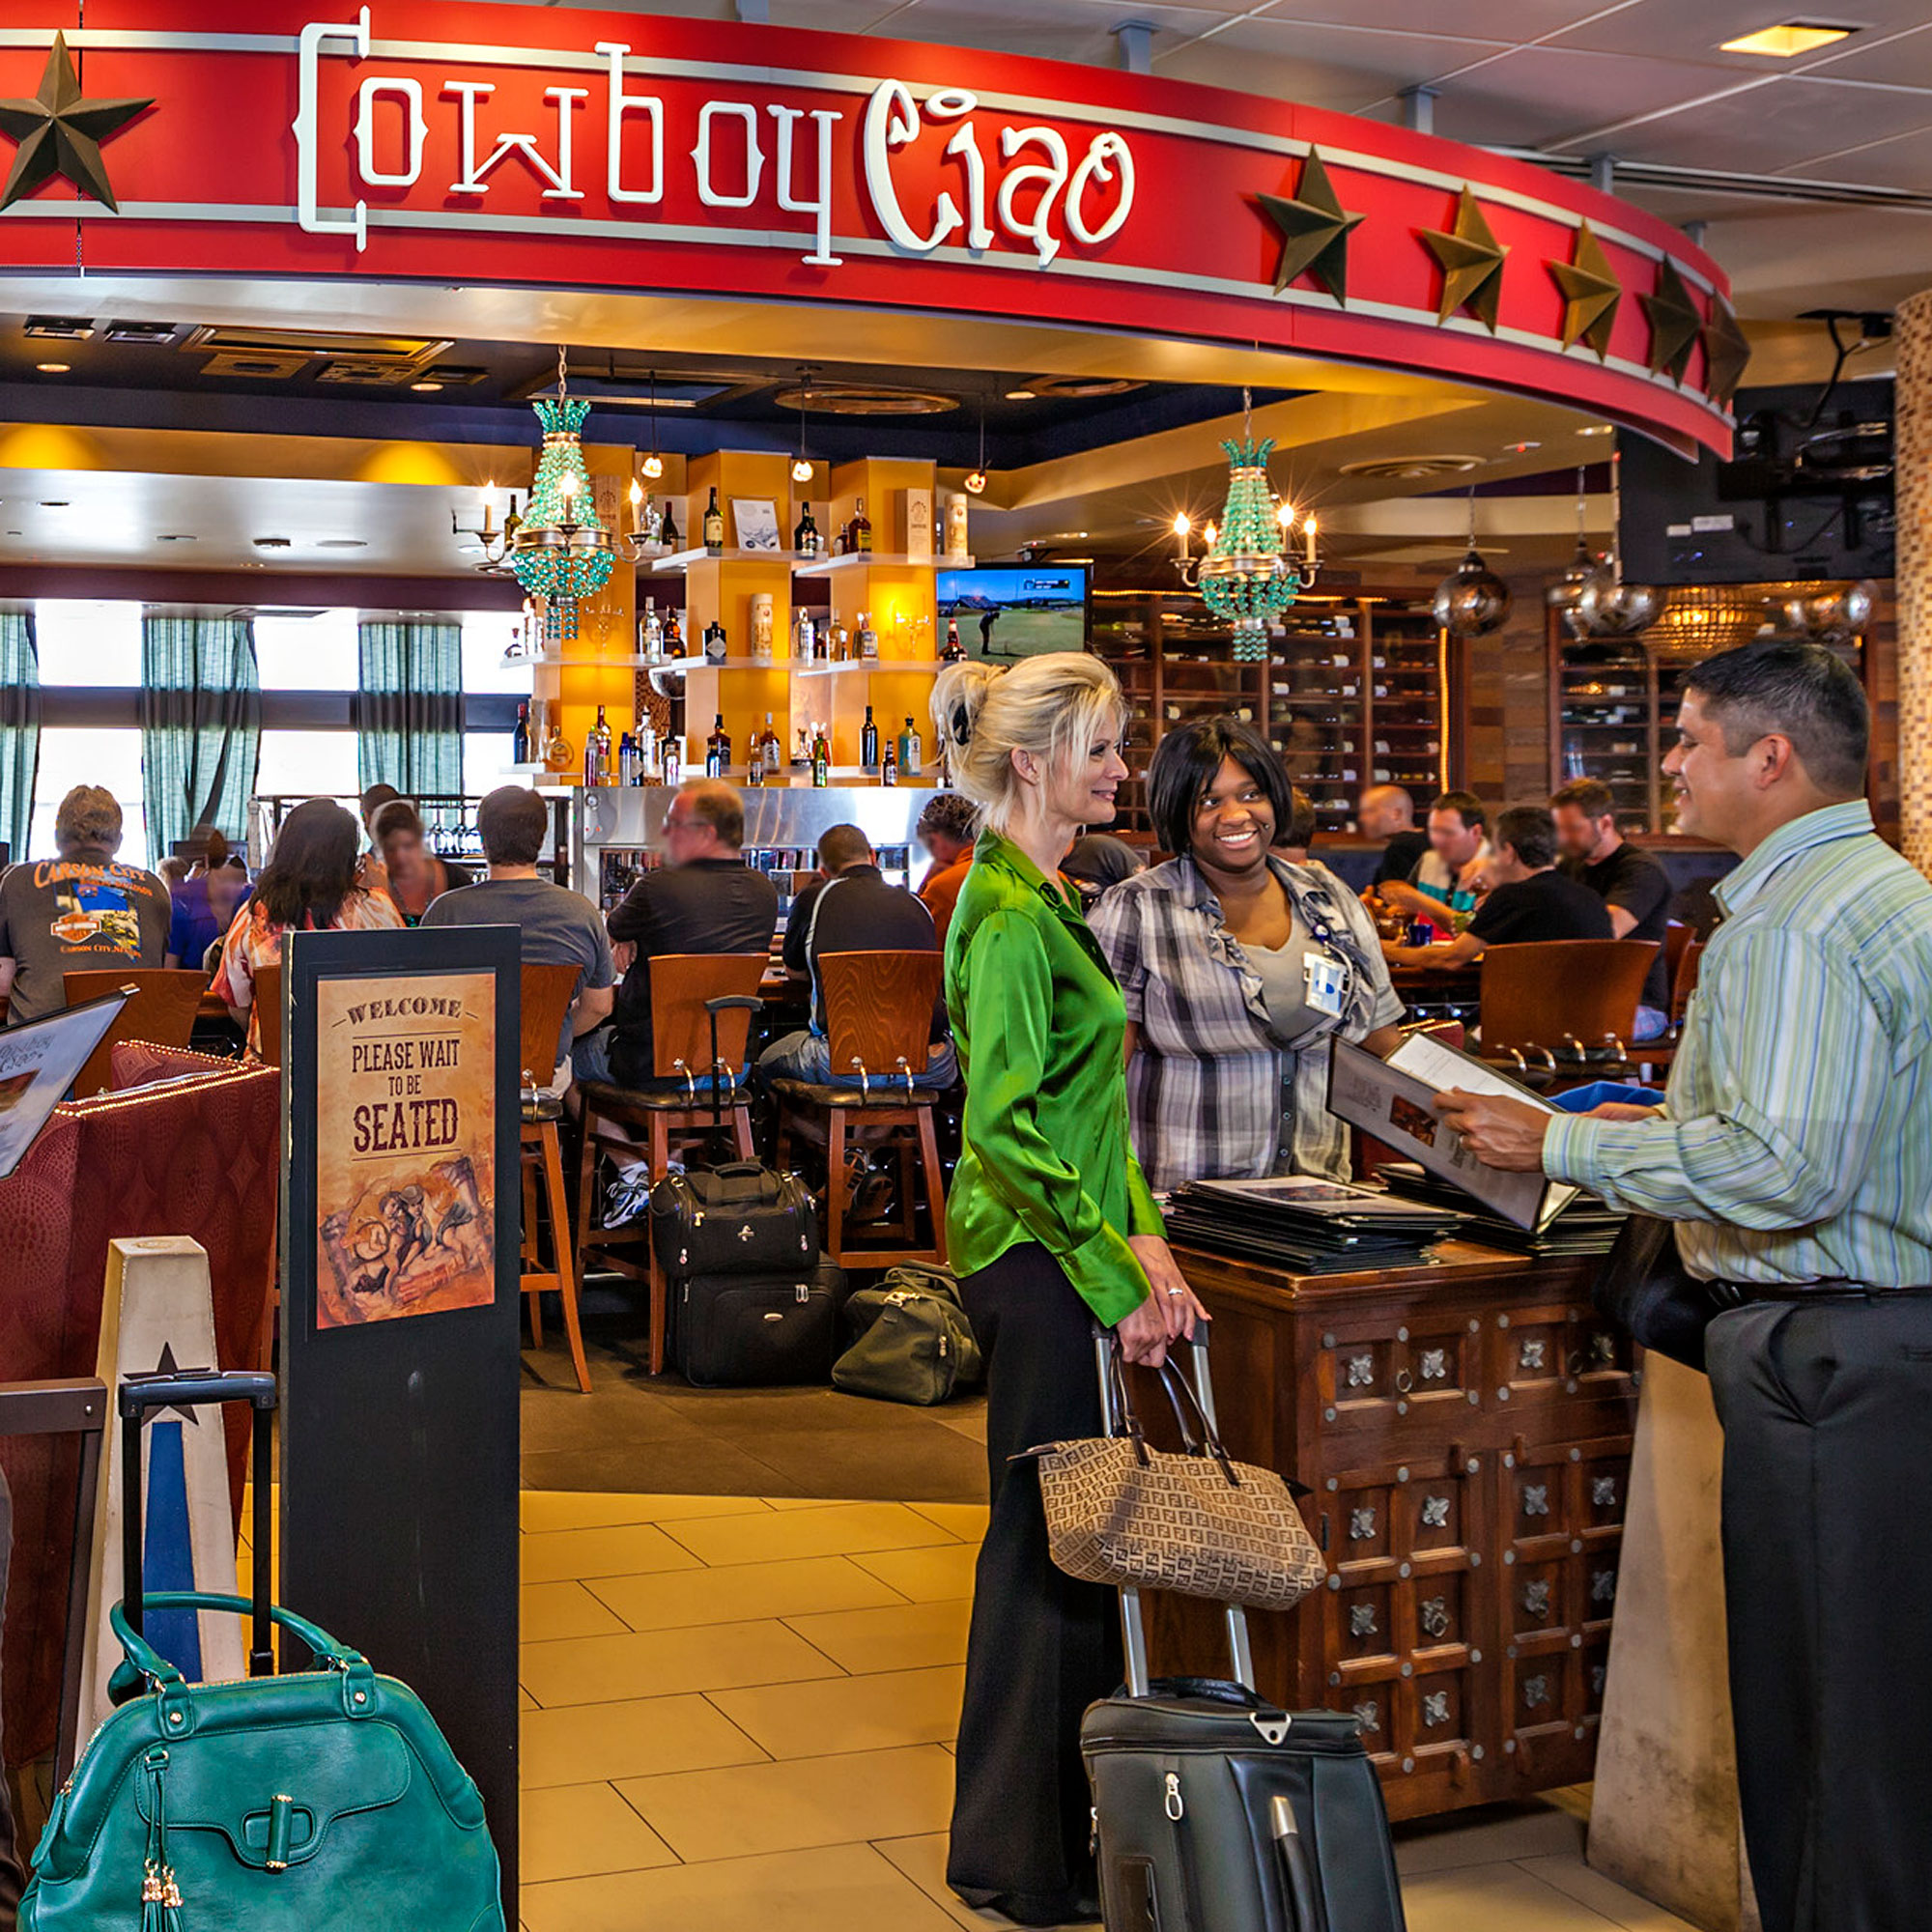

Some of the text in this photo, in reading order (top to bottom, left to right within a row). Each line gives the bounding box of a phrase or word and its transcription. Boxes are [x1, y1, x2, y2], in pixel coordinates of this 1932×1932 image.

[292, 5, 1135, 268] Cowboy Ciao
[347, 996, 462, 1025] WELCOME
[352, 1039, 460, 1072] PLEASE WAIT
[388, 1074, 421, 1096] TO BE
[354, 1097, 458, 1152] SEATED
